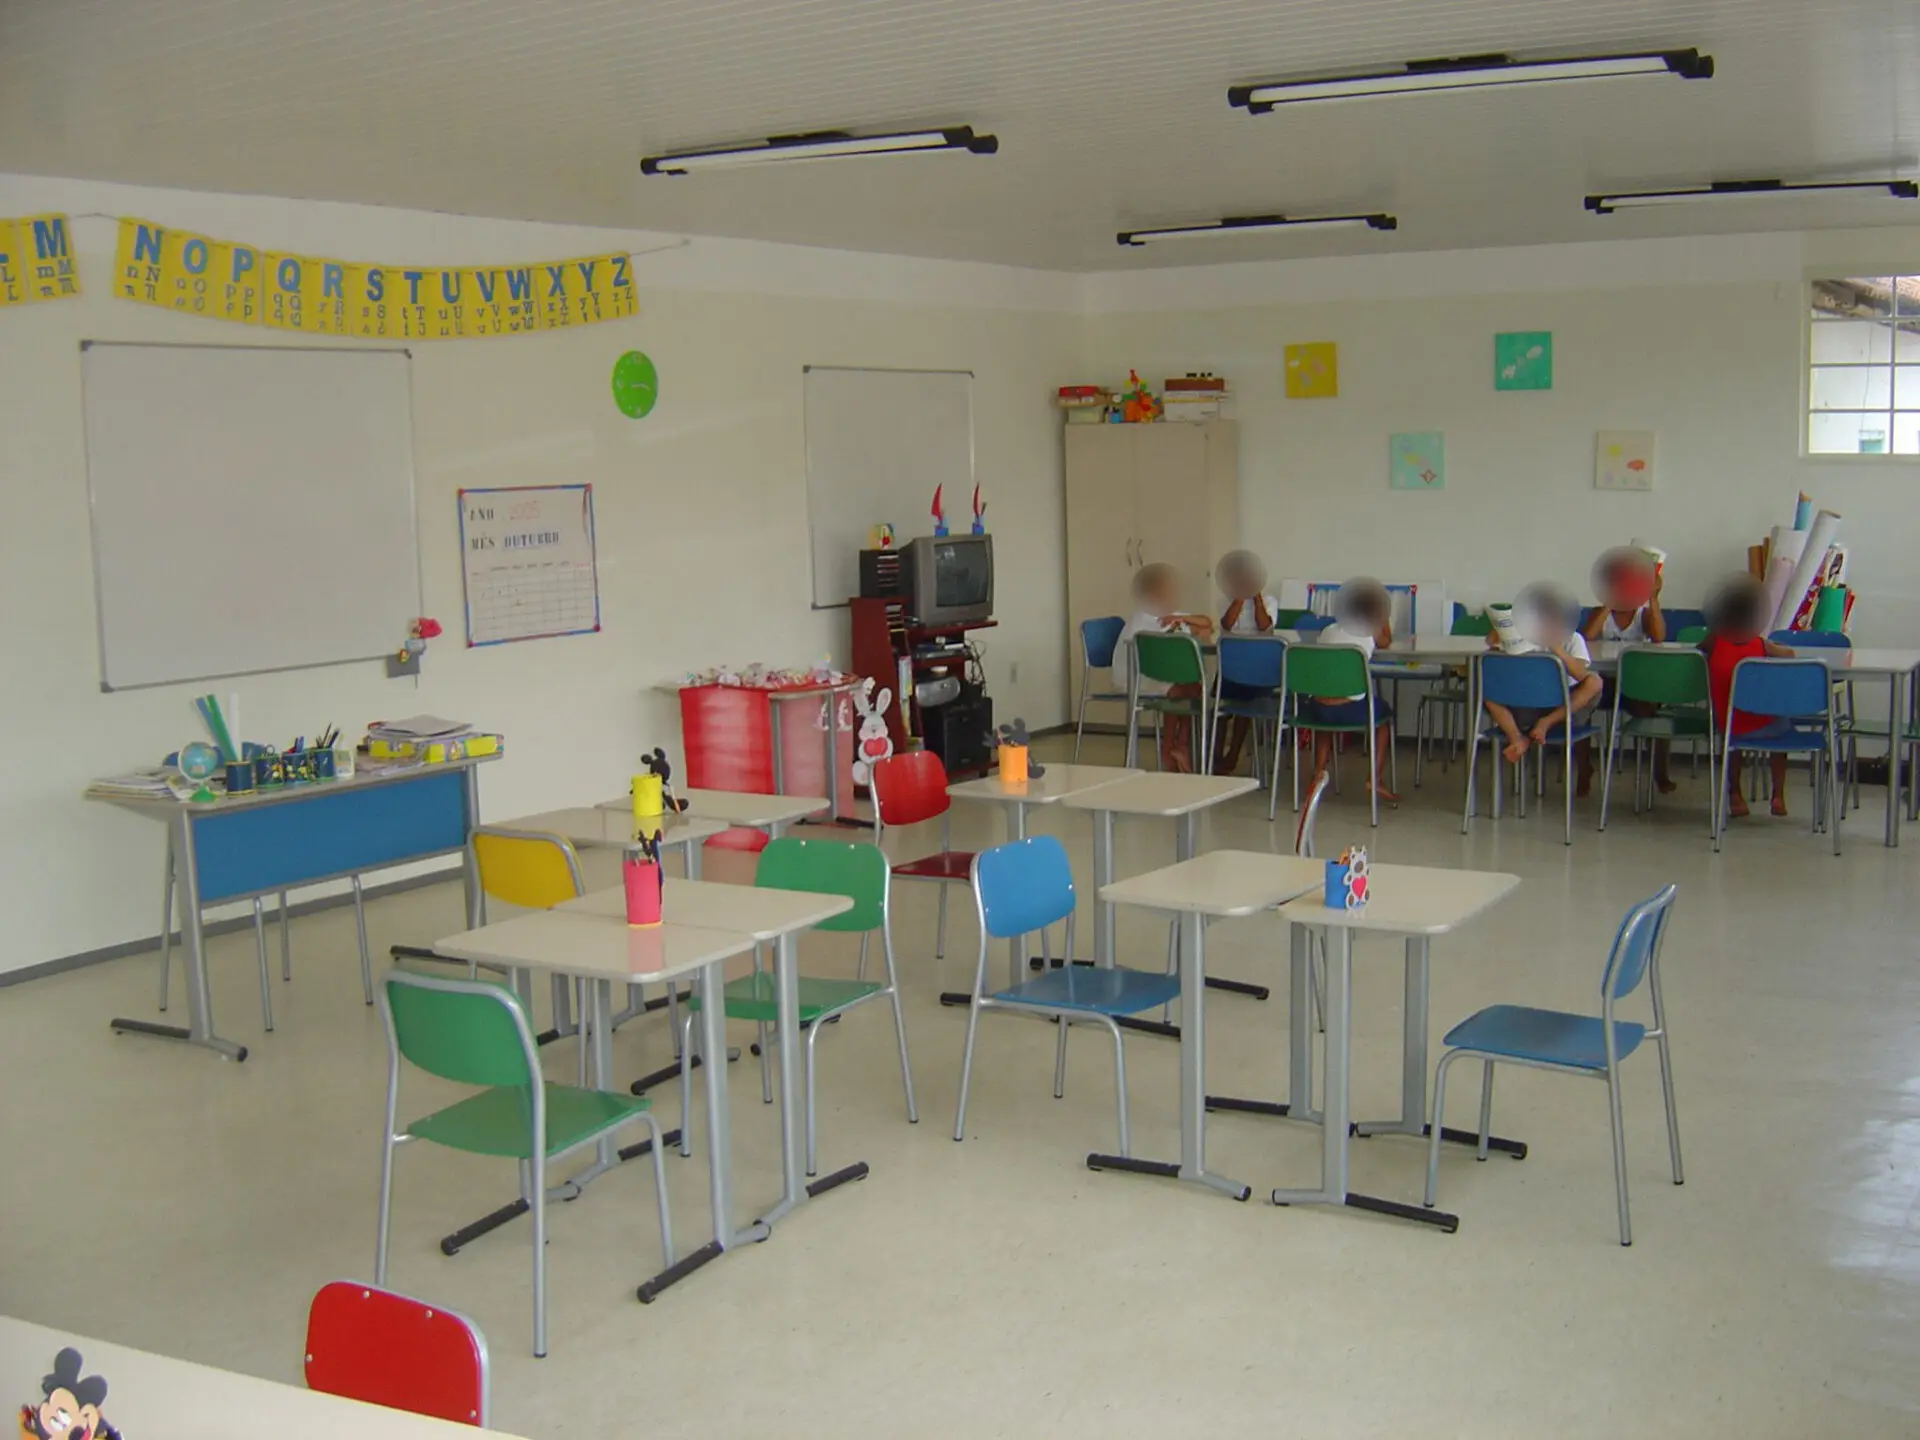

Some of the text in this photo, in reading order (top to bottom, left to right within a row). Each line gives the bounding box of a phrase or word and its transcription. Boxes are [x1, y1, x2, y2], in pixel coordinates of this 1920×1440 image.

[34, 218, 67, 260] M
[134, 223, 629, 304] N O P Q R S T U V W X Y Z
